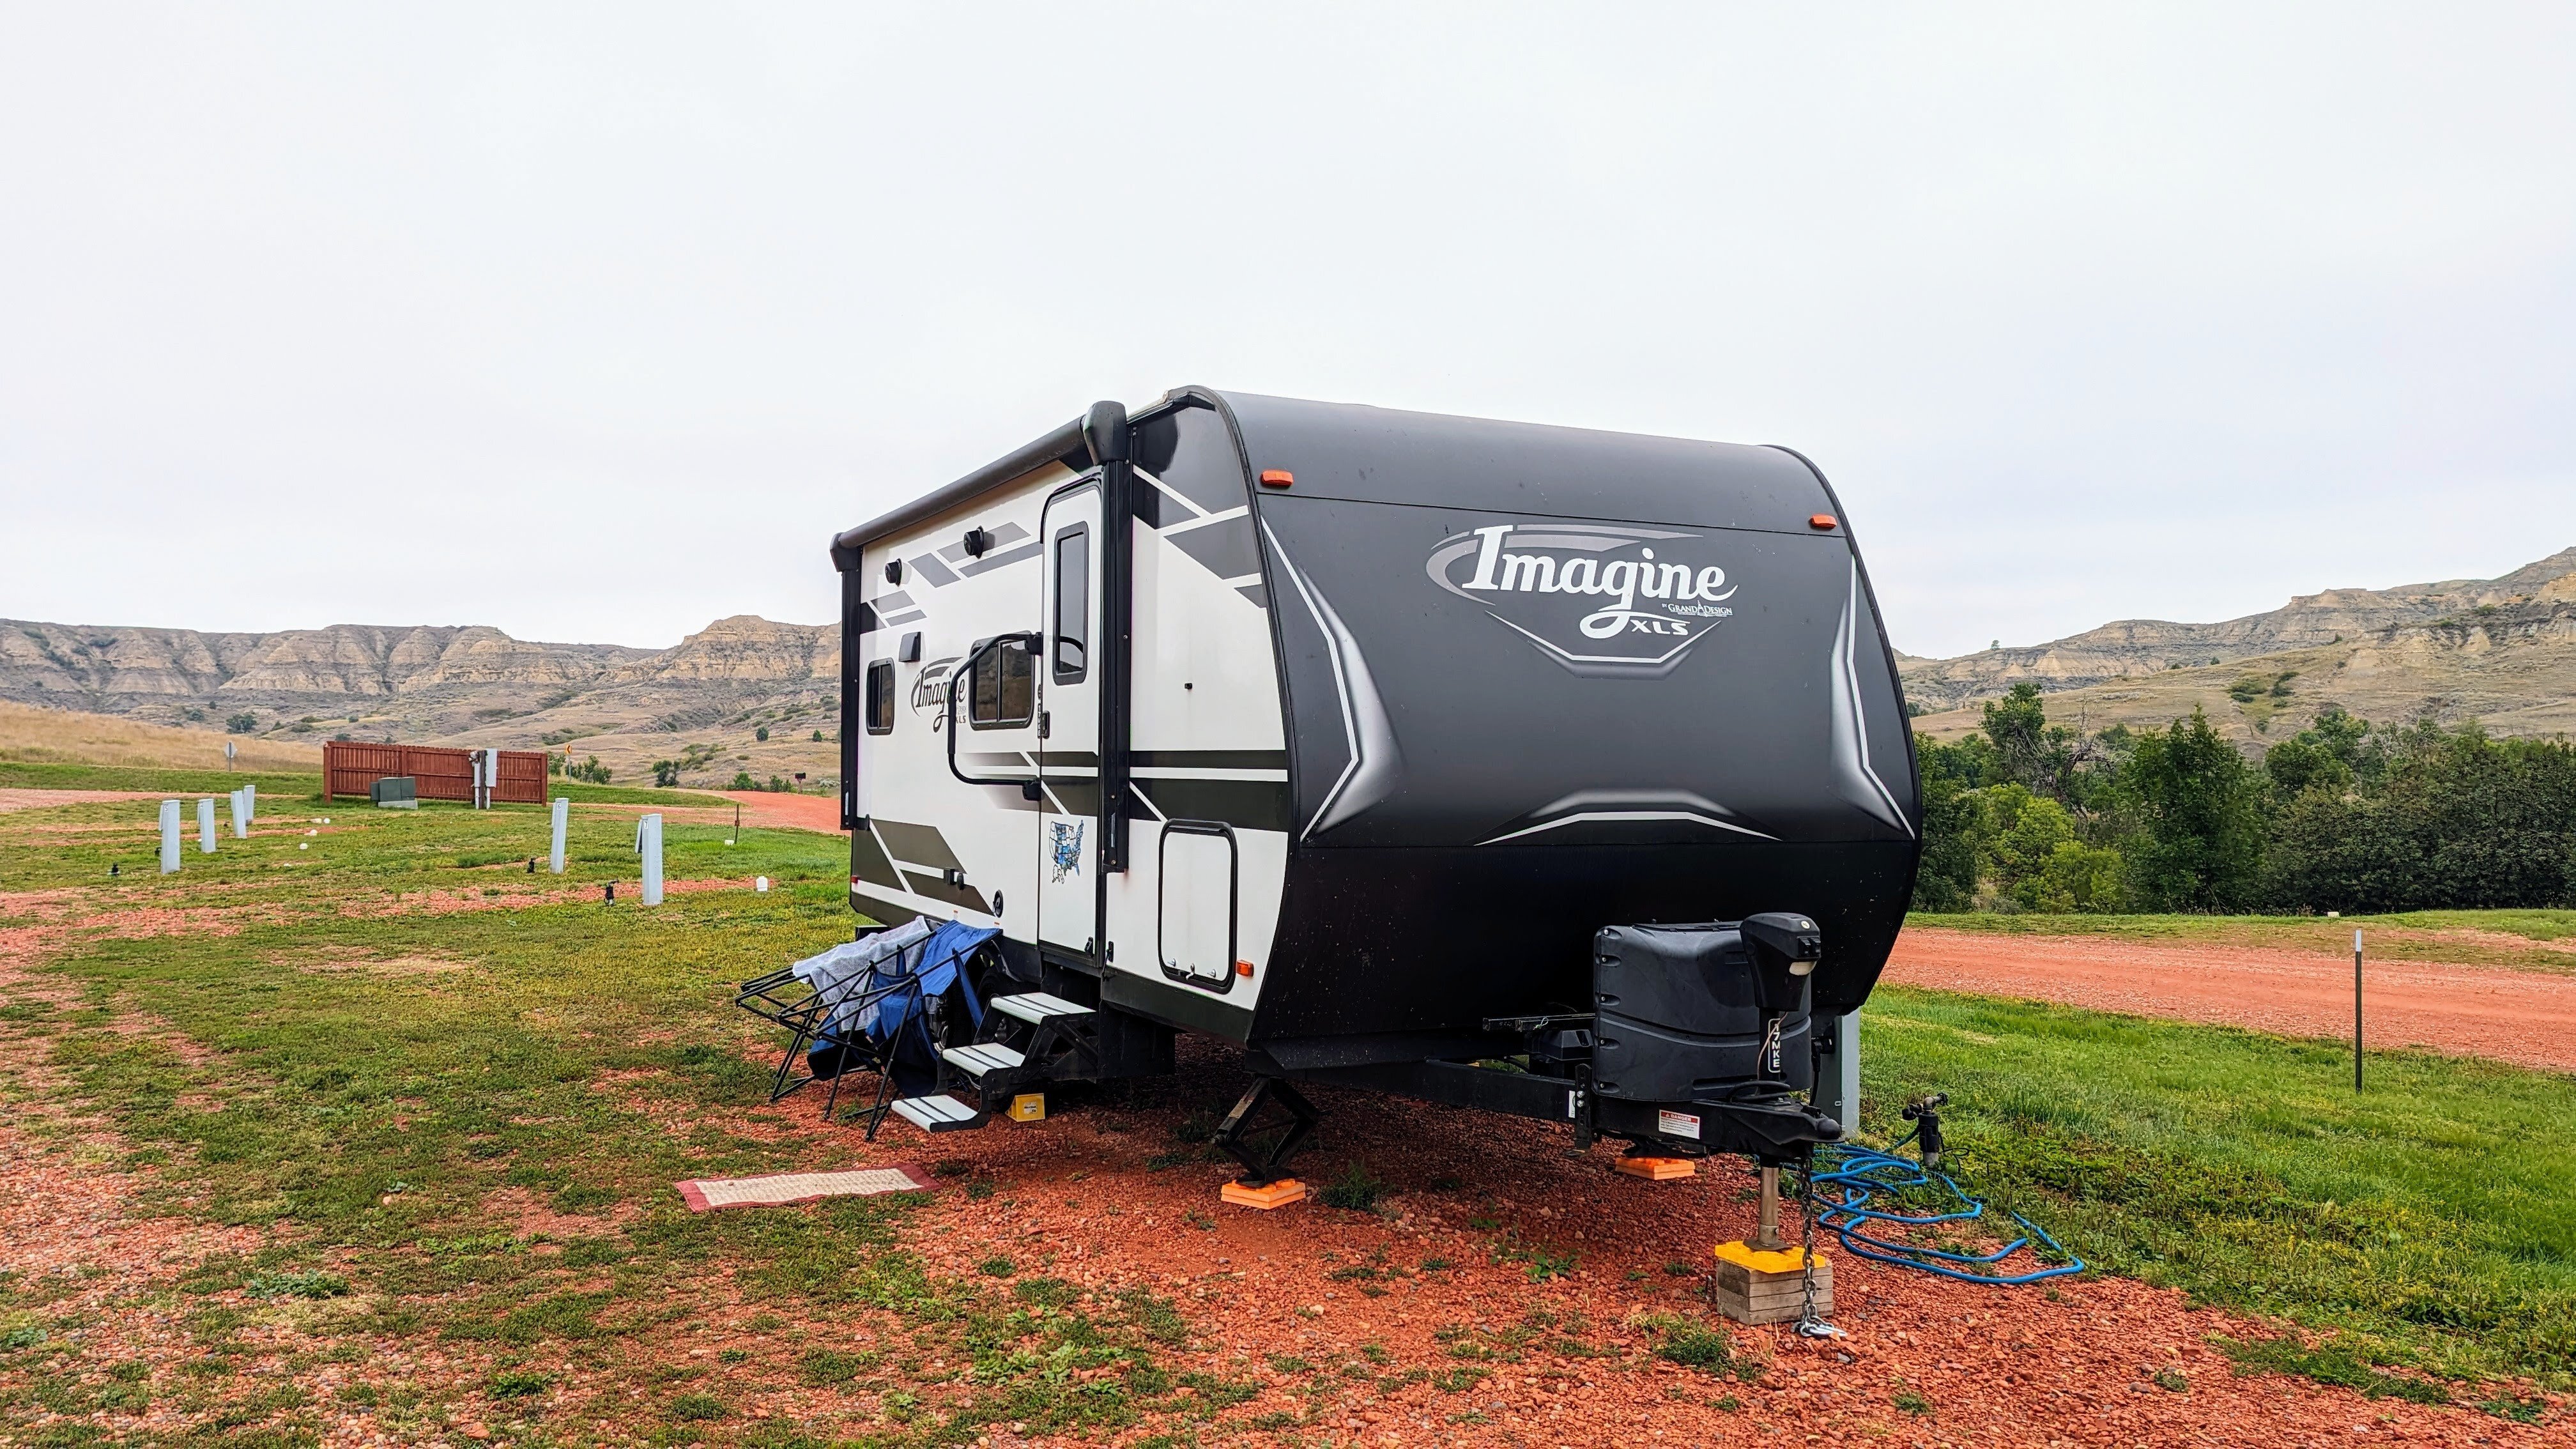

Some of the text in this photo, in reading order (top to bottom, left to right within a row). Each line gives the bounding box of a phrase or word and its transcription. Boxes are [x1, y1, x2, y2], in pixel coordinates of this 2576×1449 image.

[1462, 525, 1738, 639] Imagine
[1630, 619, 1689, 636] XLS
[1670, 1114, 1692, 1122] DANGER
